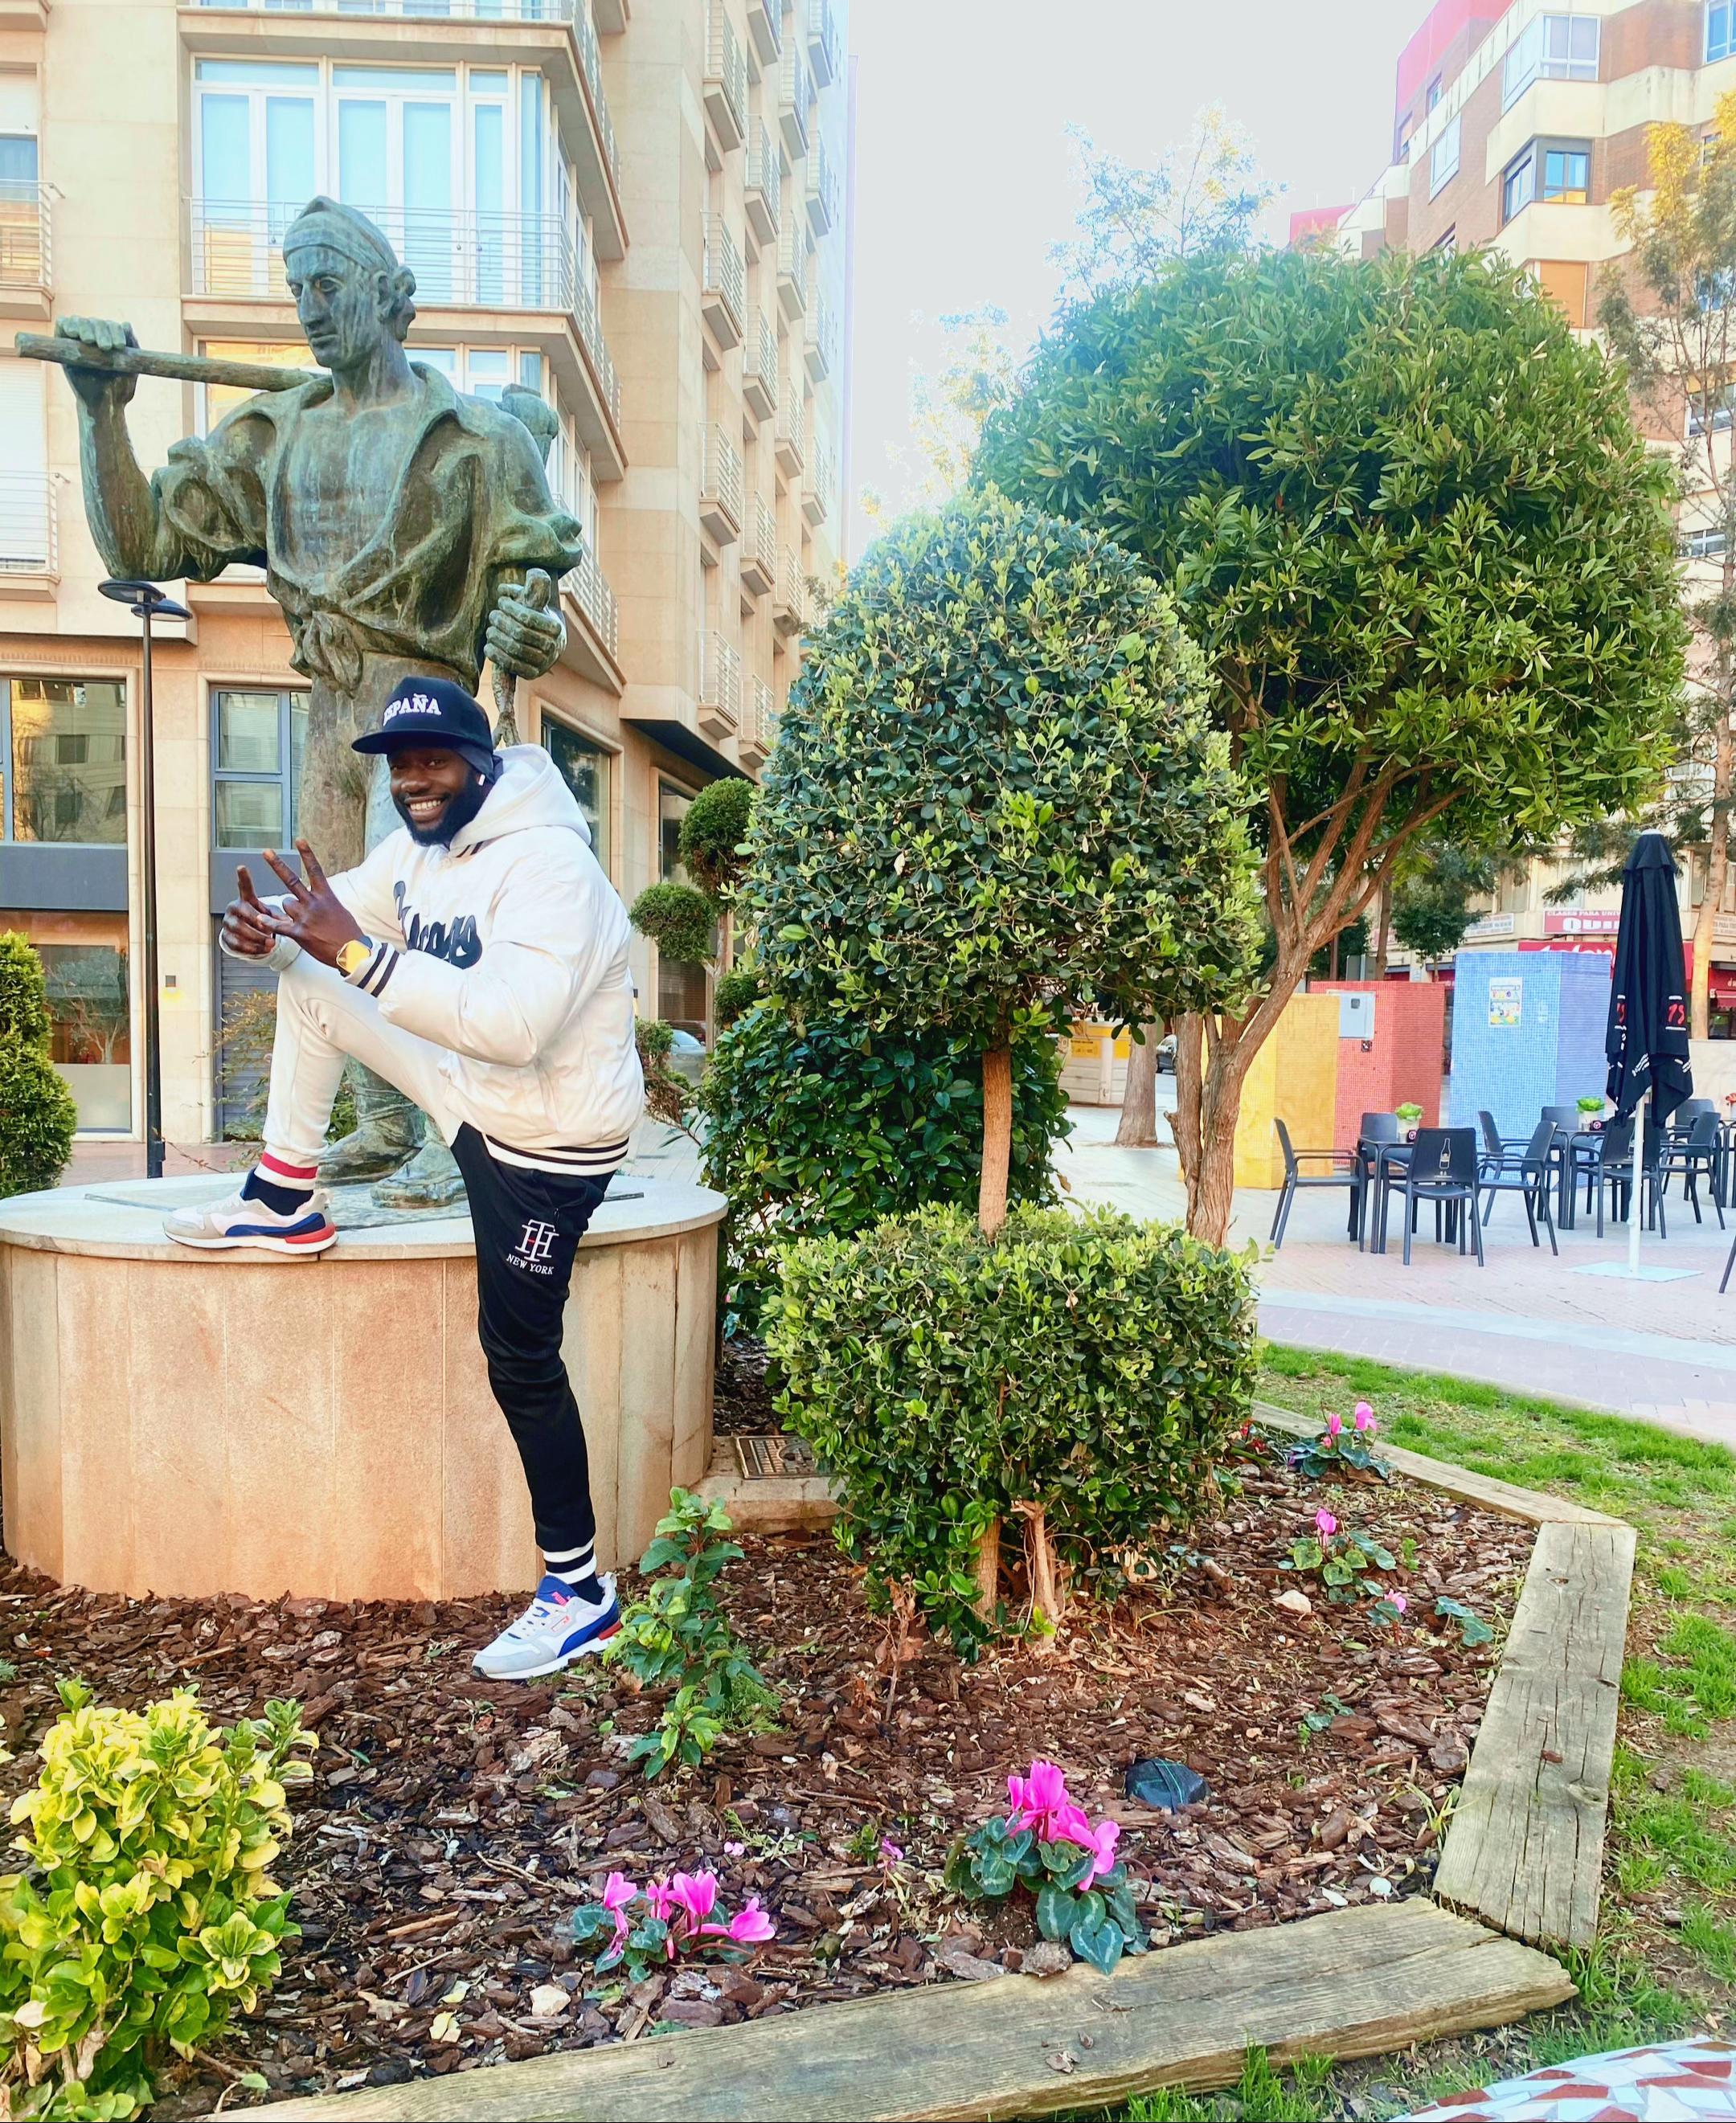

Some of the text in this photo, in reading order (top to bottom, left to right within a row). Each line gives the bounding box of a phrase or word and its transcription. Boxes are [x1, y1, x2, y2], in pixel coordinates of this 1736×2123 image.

[383, 693, 442, 726] ESPAÑA
[506, 1254, 555, 1275] NEW YORK
